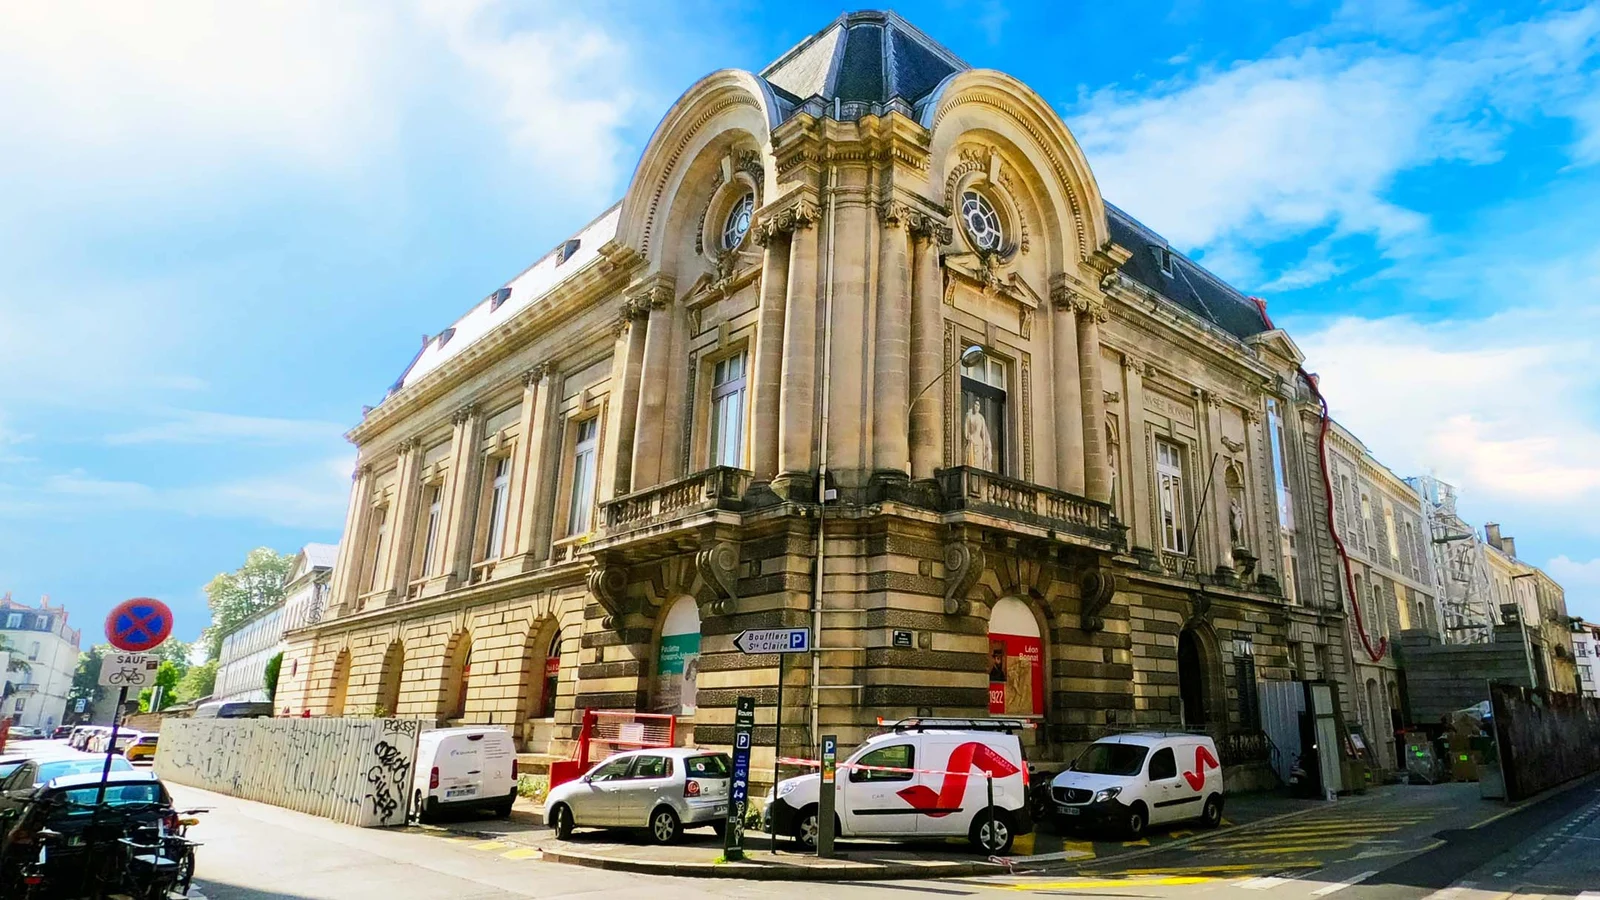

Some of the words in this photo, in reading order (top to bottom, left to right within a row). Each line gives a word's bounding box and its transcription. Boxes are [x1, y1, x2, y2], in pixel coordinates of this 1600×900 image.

[748, 632, 788, 641] Boufflers
[792, 634, 802, 647] P
[763, 642, 788, 650] Claire
[1025, 645, 1038, 653] Léon
[116, 655, 147, 665] SAUF
[989, 690, 1004, 704] 1922
[825, 740, 834, 753] P
